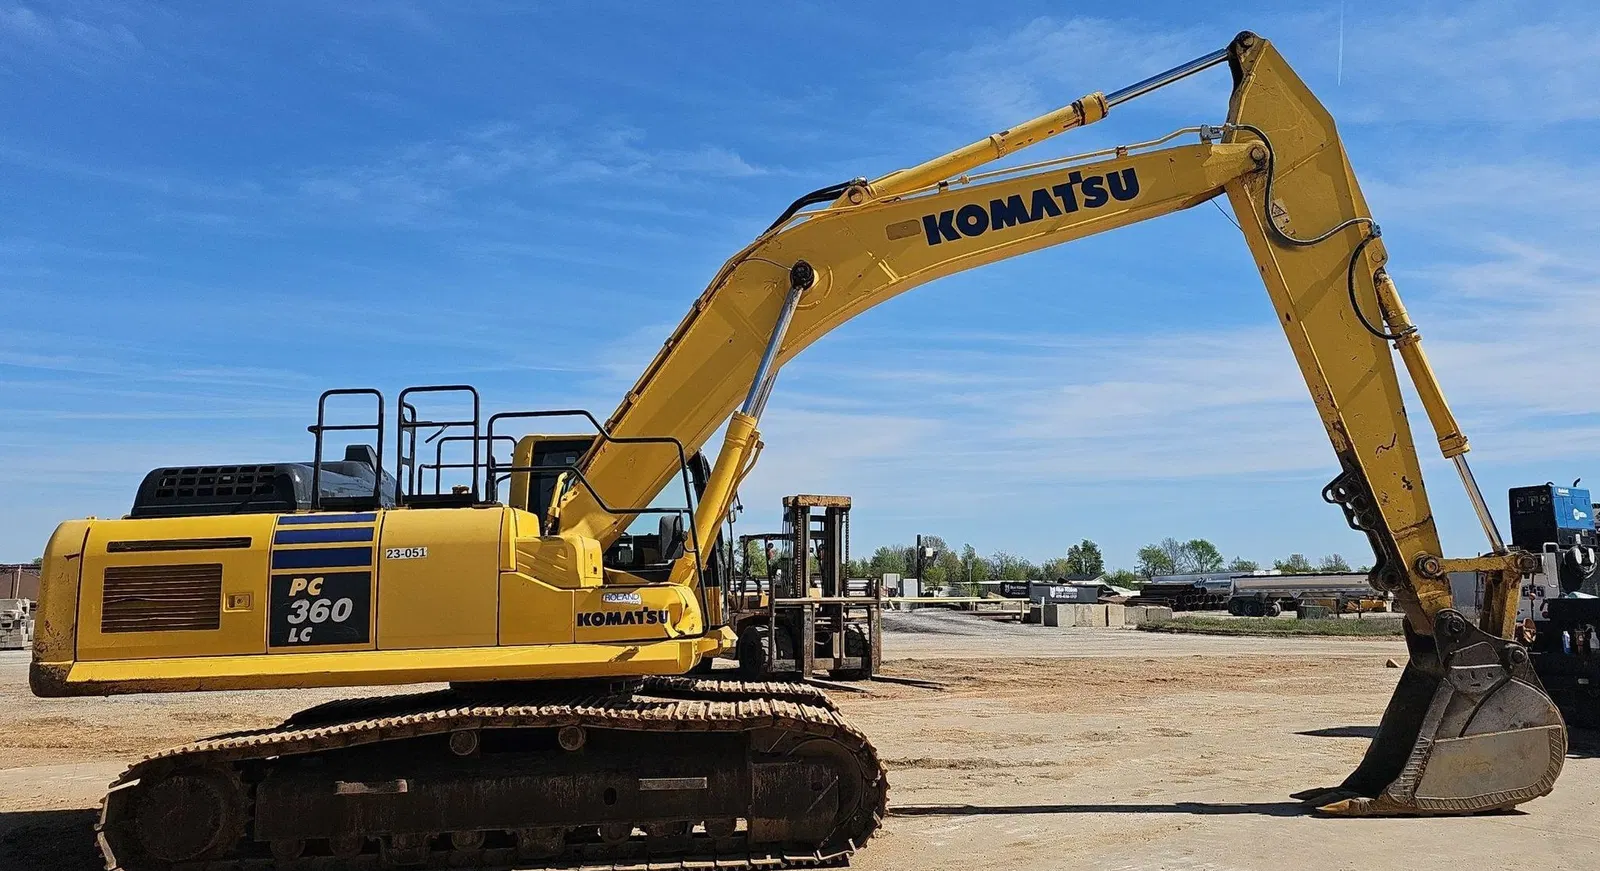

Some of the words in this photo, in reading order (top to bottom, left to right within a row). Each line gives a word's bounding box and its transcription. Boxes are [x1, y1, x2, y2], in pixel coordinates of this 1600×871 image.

[922, 167, 1140, 246] KOMATSU
[386, 548, 426, 559] 23-051
[288, 577, 324, 597] PC
[287, 597, 353, 624] 360
[577, 606, 669, 627] KOMATSU
[288, 627, 313, 642] LC
